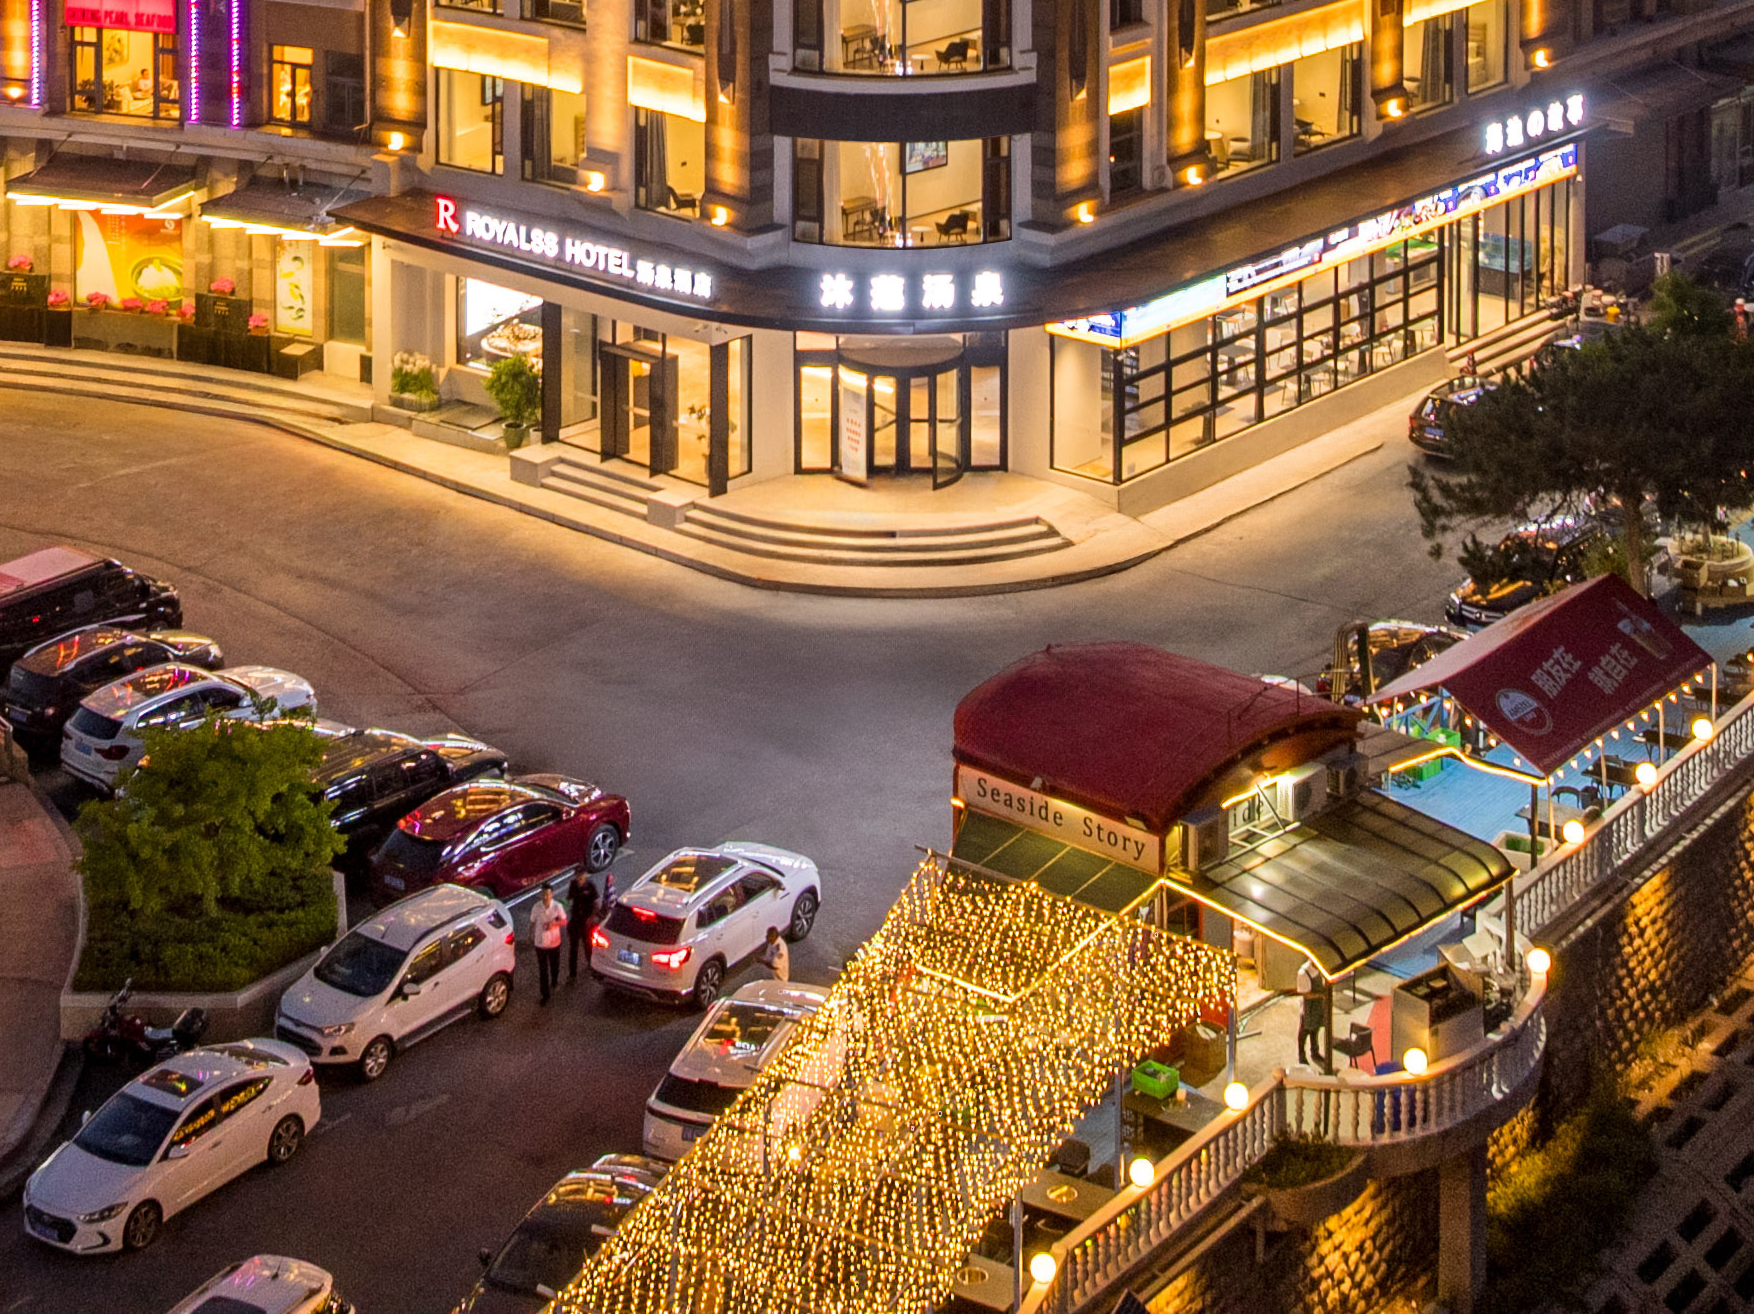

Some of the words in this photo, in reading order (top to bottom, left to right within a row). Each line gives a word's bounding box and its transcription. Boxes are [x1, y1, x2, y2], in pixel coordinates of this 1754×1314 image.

[435, 196, 461, 235] R
[465, 211, 559, 259] ROYALSS
[564, 237, 635, 279] HOTEL
[1530, 644, 1582, 700] 朋友在
[1587, 641, 1639, 695] 就自在
[976, 776, 1065, 828] Seaside
[1082, 815, 1147, 862] Story
